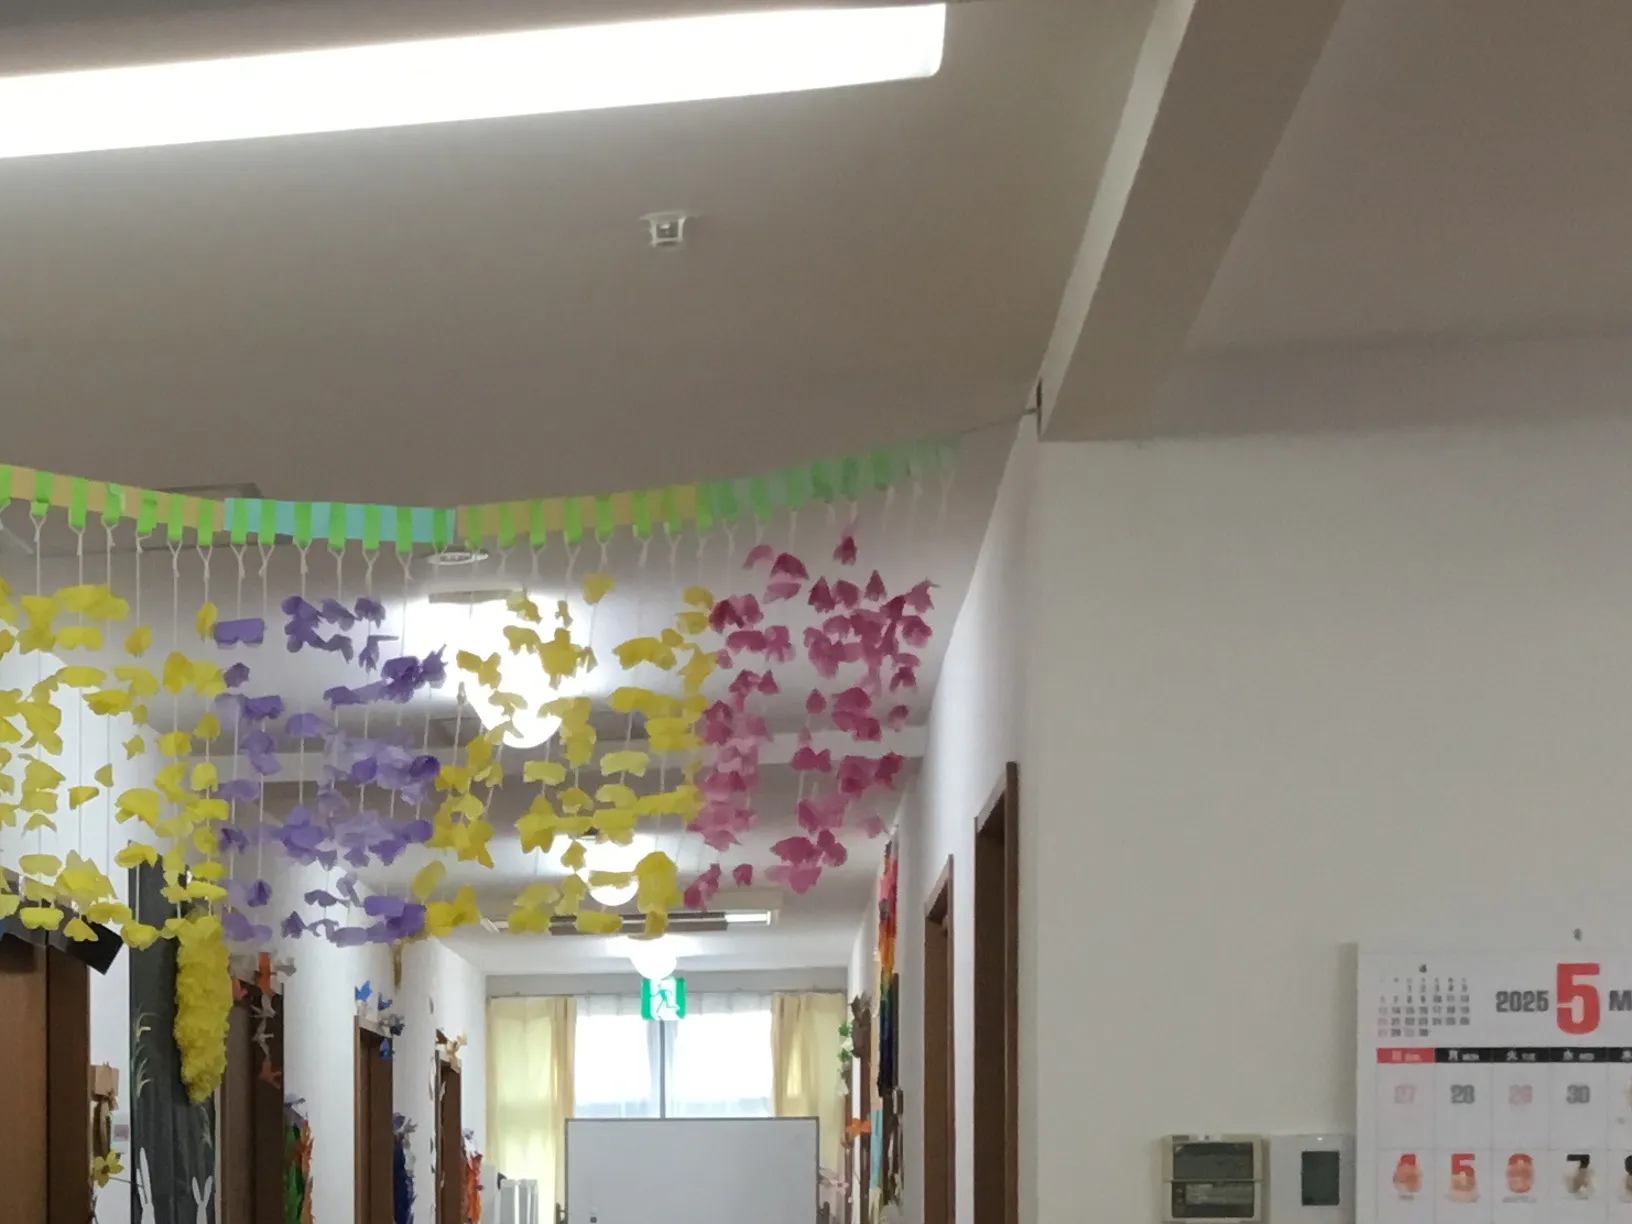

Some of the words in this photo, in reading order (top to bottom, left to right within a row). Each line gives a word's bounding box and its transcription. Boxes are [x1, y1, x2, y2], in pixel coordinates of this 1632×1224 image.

[1495, 990, 1549, 1012] 2025
[1556, 963, 1600, 1034] 5
[1450, 1085, 1475, 1104] 28
[1567, 1085, 1590, 1104] 30
[1451, 1153, 1476, 1192] 5
[1567, 1154, 1591, 1194] 7
